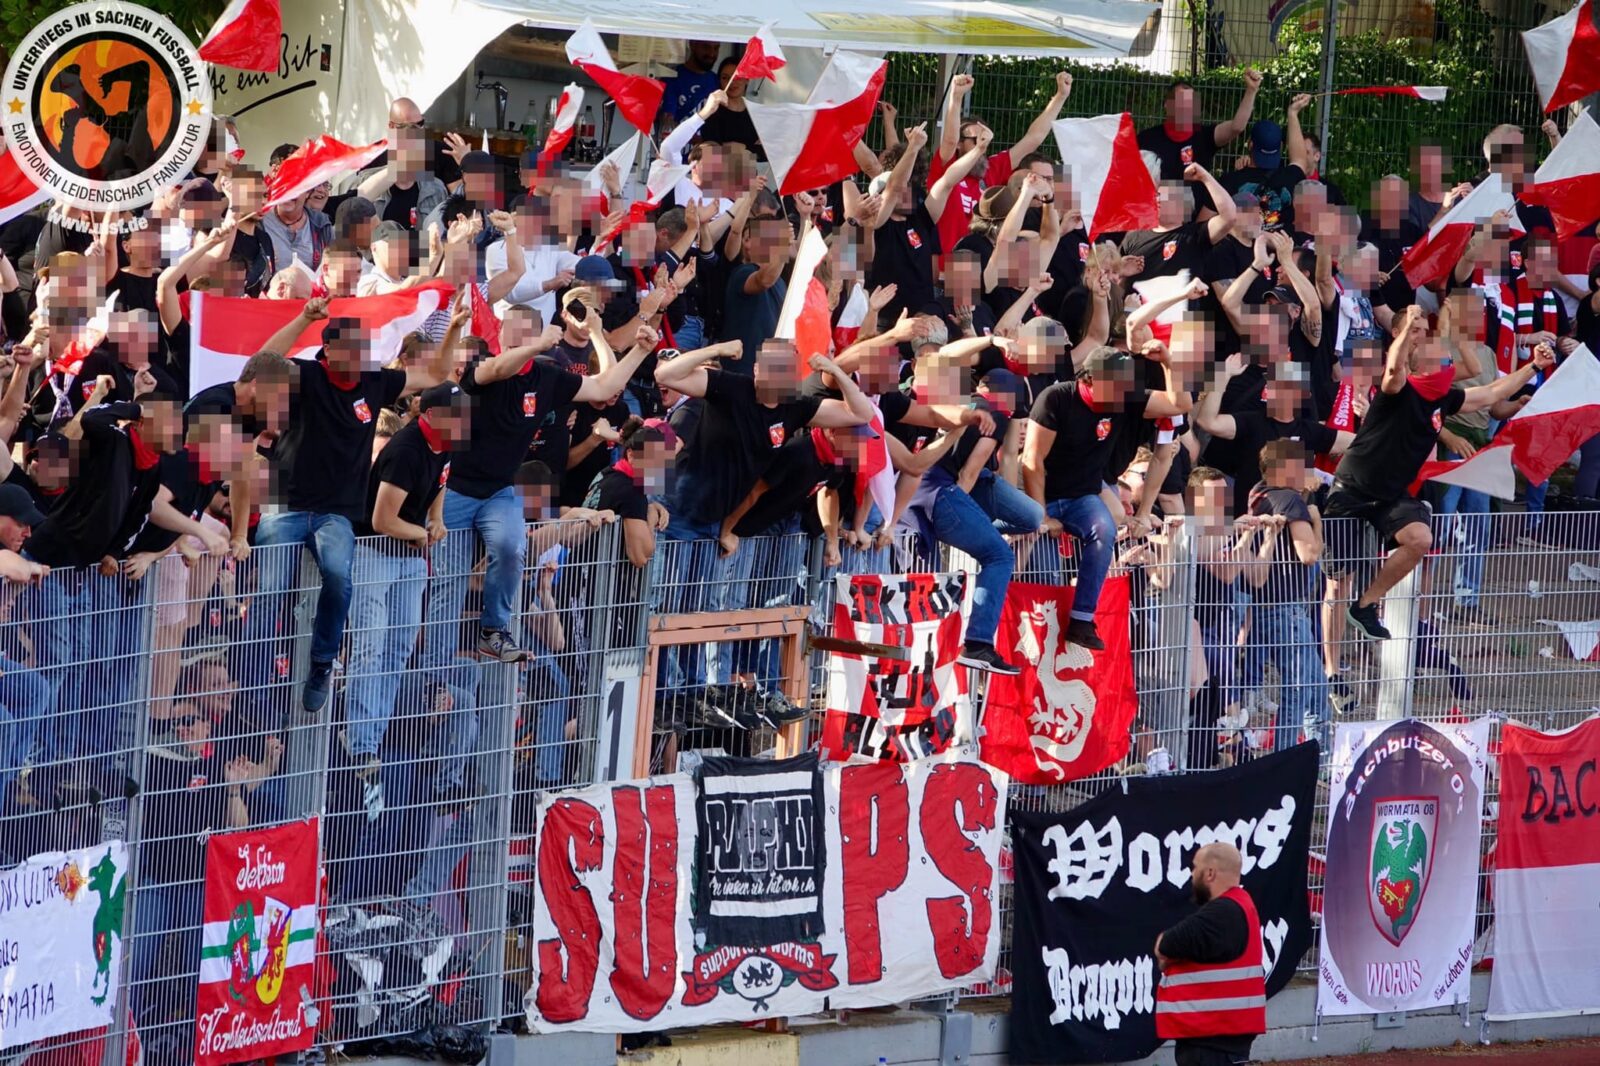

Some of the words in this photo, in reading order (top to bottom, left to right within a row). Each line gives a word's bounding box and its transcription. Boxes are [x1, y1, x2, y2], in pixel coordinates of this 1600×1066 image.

[1377, 803, 1420, 818] WORMATIA
[1423, 803, 1435, 816] 08
[1521, 758, 1600, 824] BAC
[1042, 794, 1296, 901] Worms
